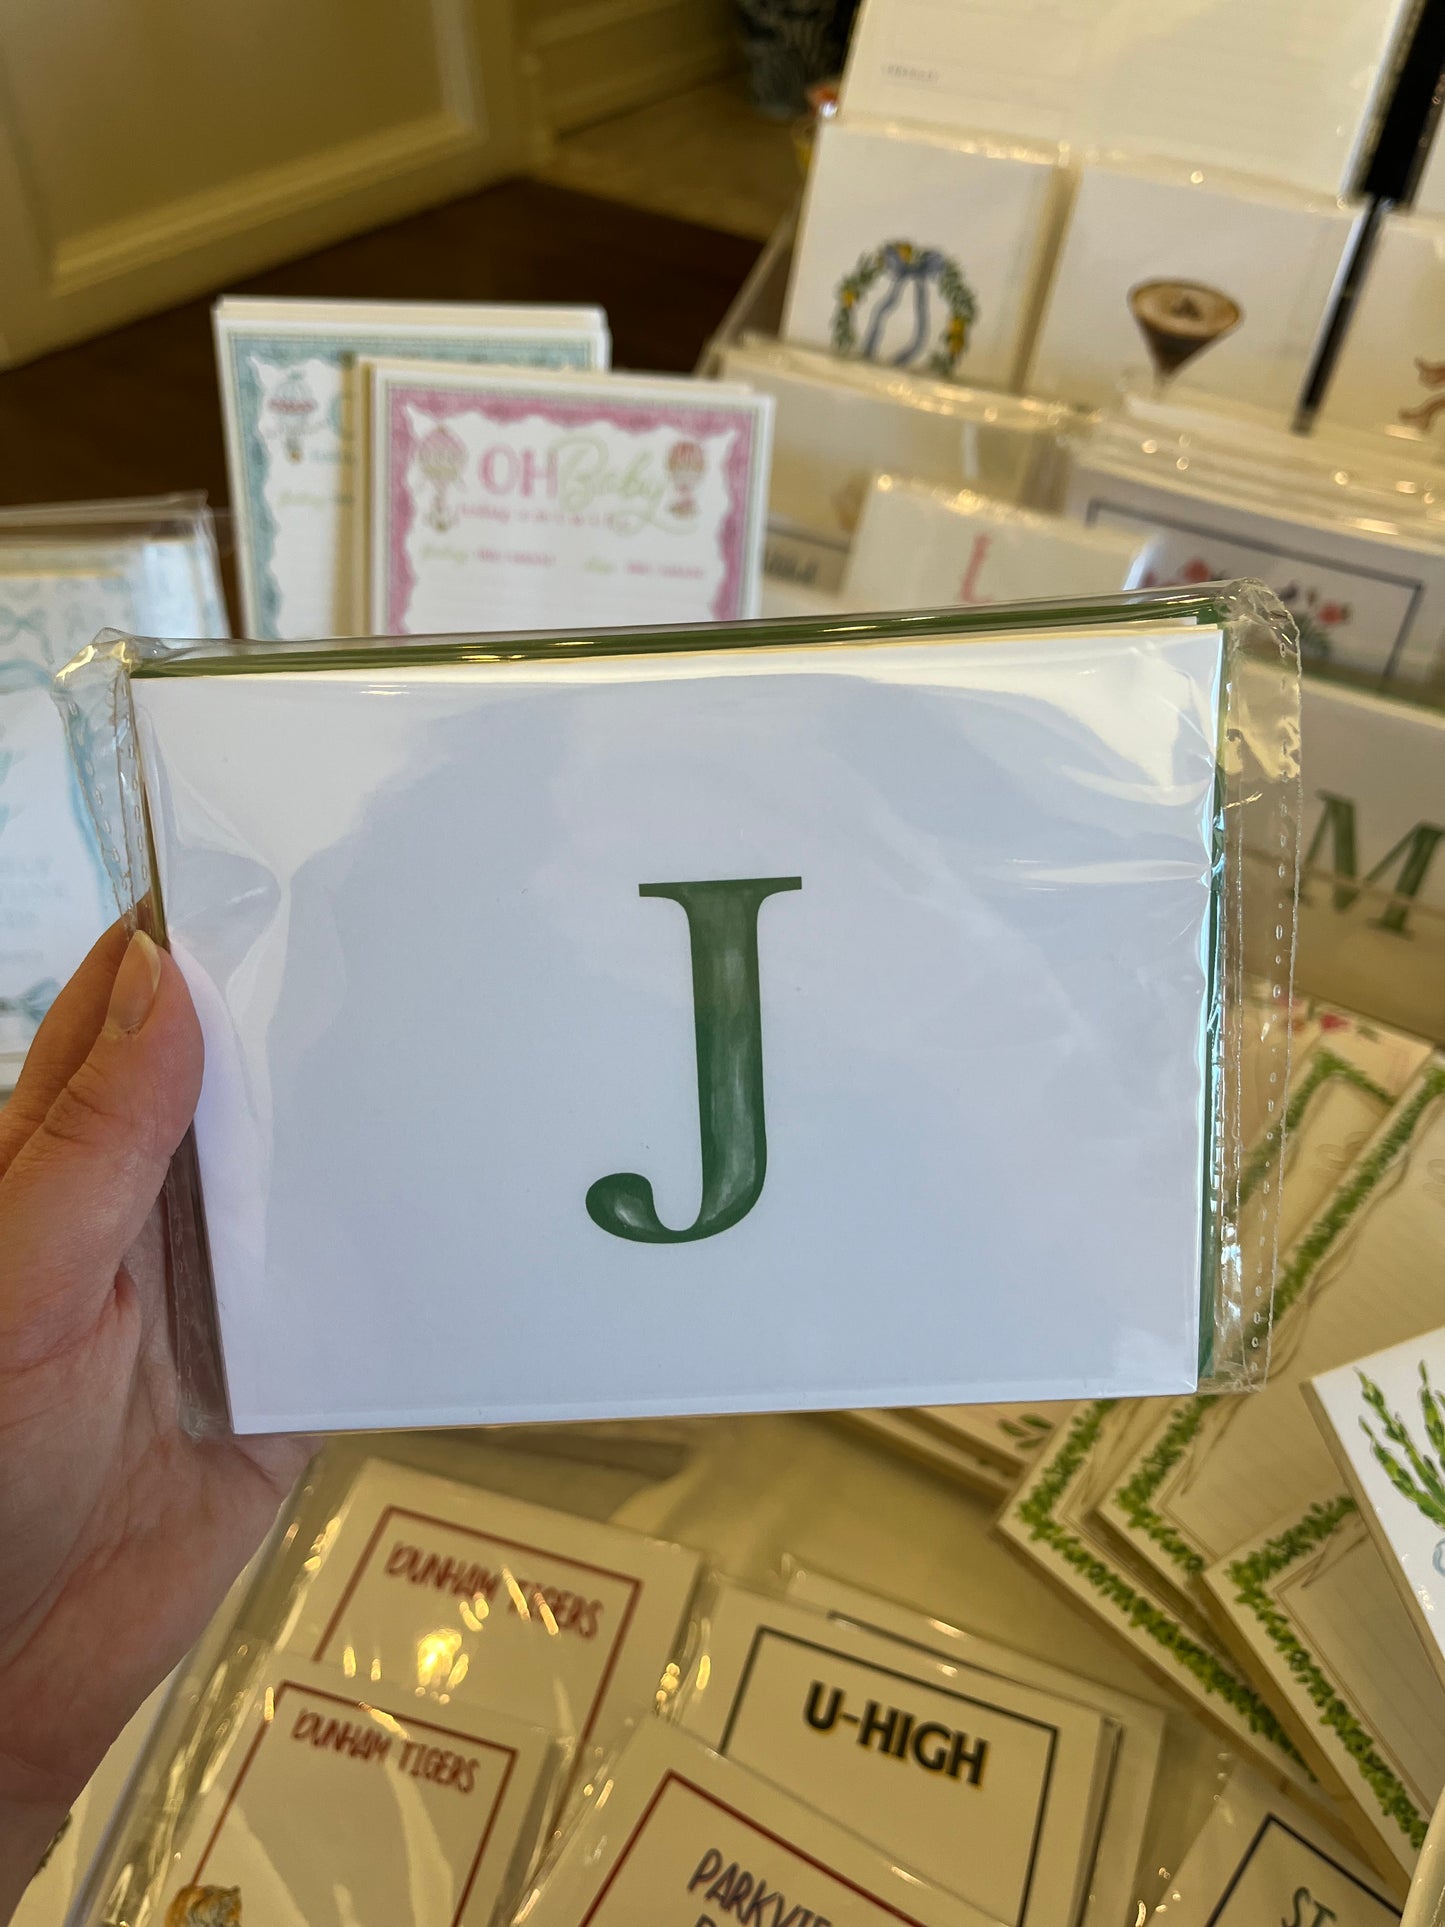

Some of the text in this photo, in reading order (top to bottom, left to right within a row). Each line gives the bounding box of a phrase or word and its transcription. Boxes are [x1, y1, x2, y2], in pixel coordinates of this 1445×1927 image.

[477, 445, 559, 498] OH
[1286, 788, 1445, 942] M
[585, 875, 803, 1244] J
[385, 1541, 500, 1603] DUNHAM
[291, 1706, 481, 1795] DUNHAM TIGERS
[803, 1679, 990, 1787] U-HIGH
